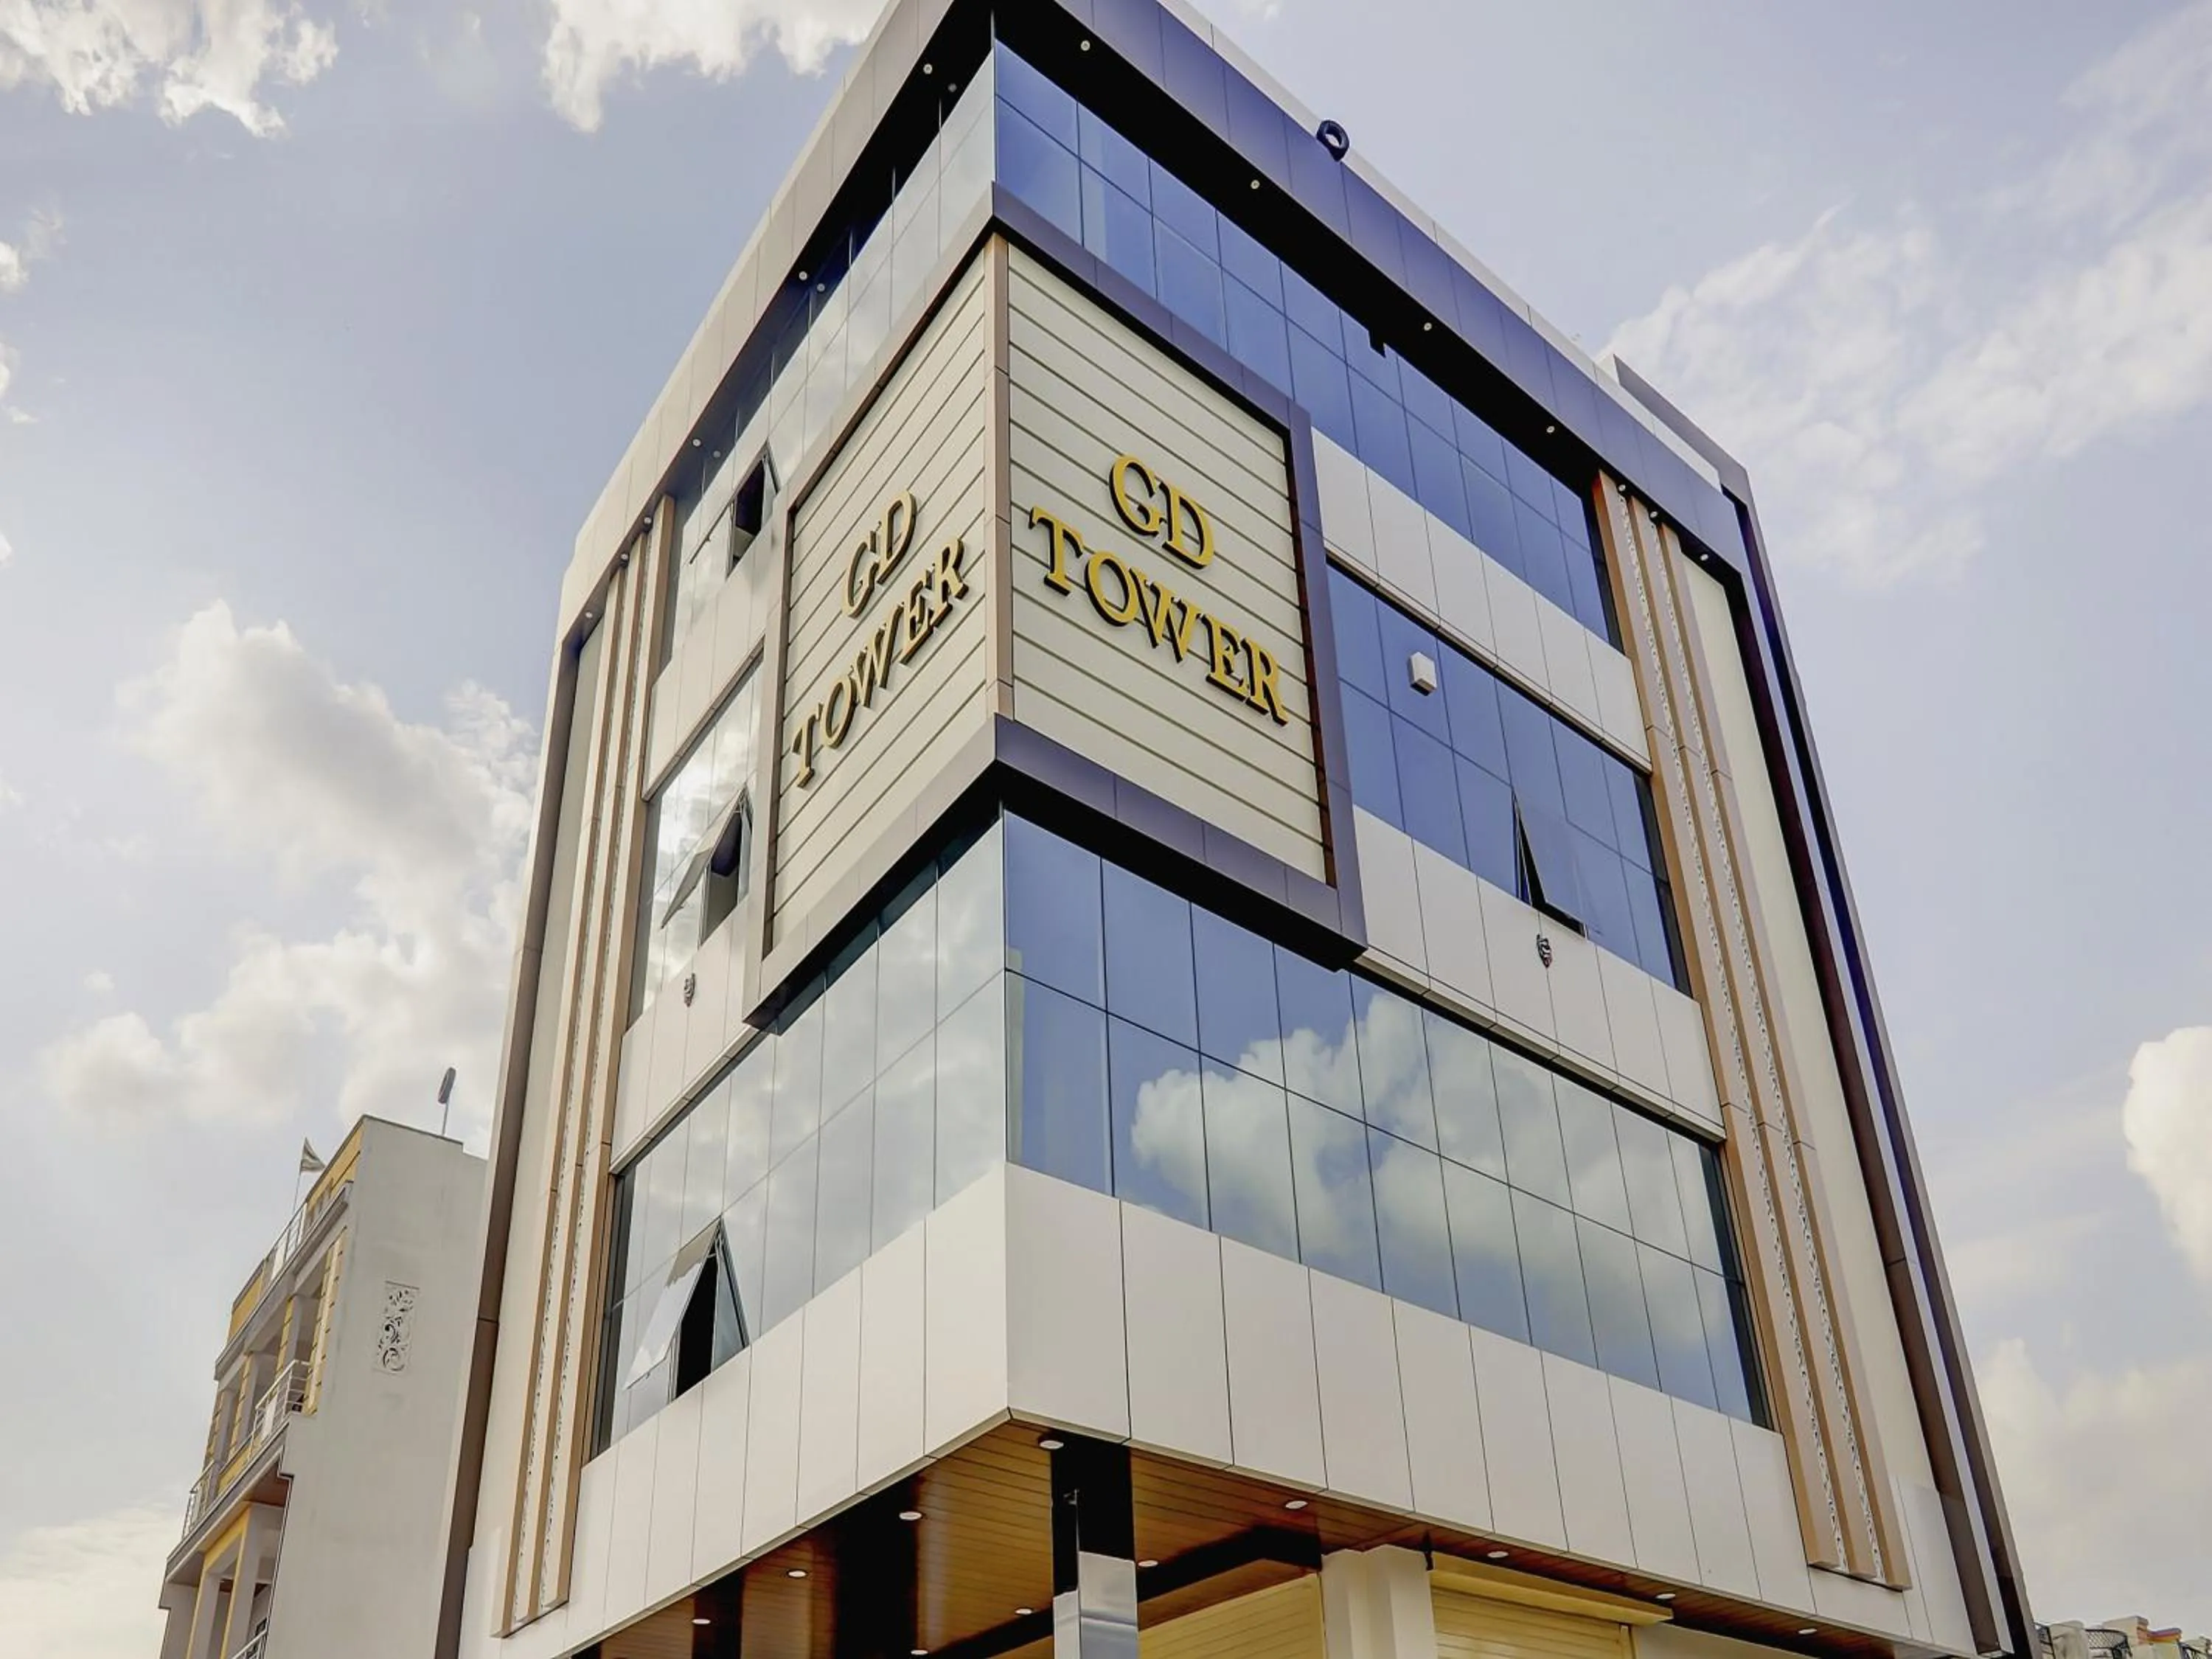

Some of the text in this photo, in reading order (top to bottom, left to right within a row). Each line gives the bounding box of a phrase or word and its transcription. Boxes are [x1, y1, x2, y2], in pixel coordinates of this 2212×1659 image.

[841, 490, 917, 619] GD
[1108, 453, 1215, 571] GD
[792, 538, 969, 788] TOWER
[1029, 505, 1288, 726] TOWER
